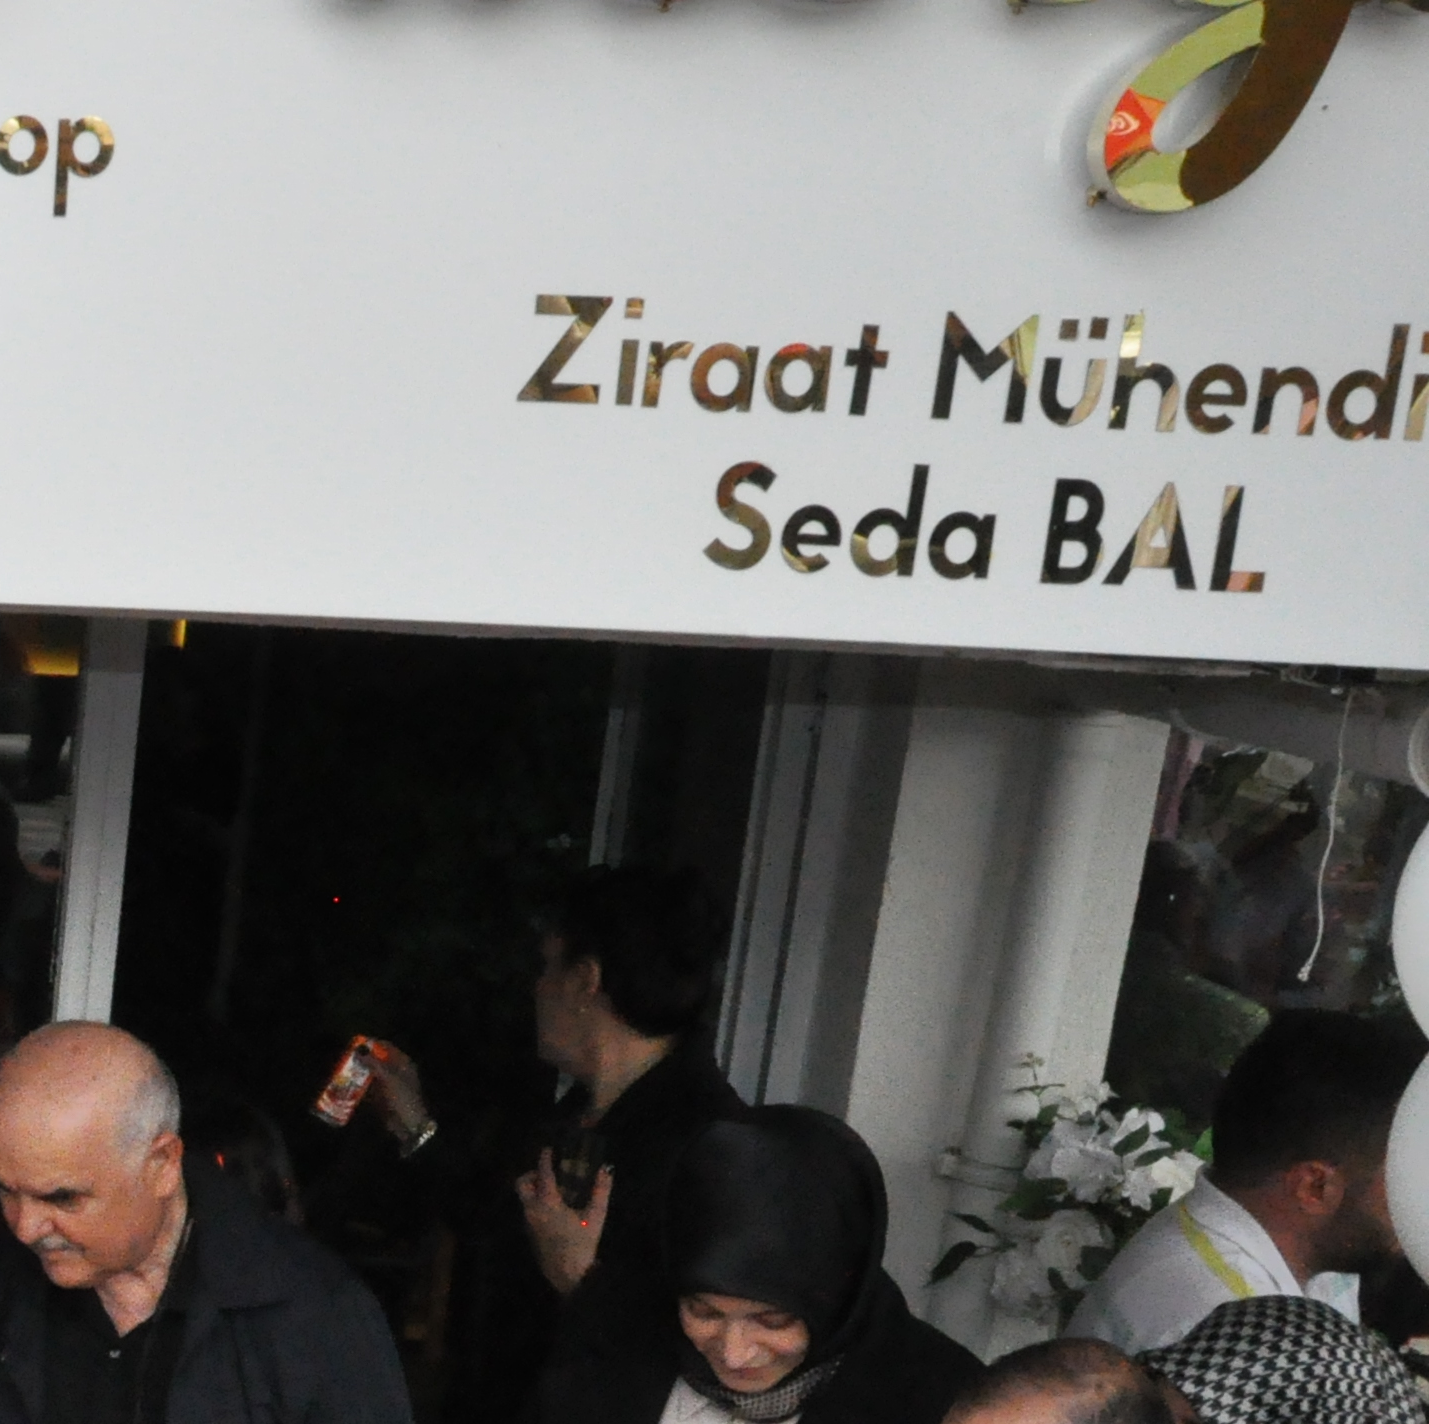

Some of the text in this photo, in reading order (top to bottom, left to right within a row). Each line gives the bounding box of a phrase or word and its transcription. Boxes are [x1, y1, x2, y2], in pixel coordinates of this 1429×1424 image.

[516, 293, 890, 418] Ziraat
[702, 460, 1267, 594] Seda BAL
